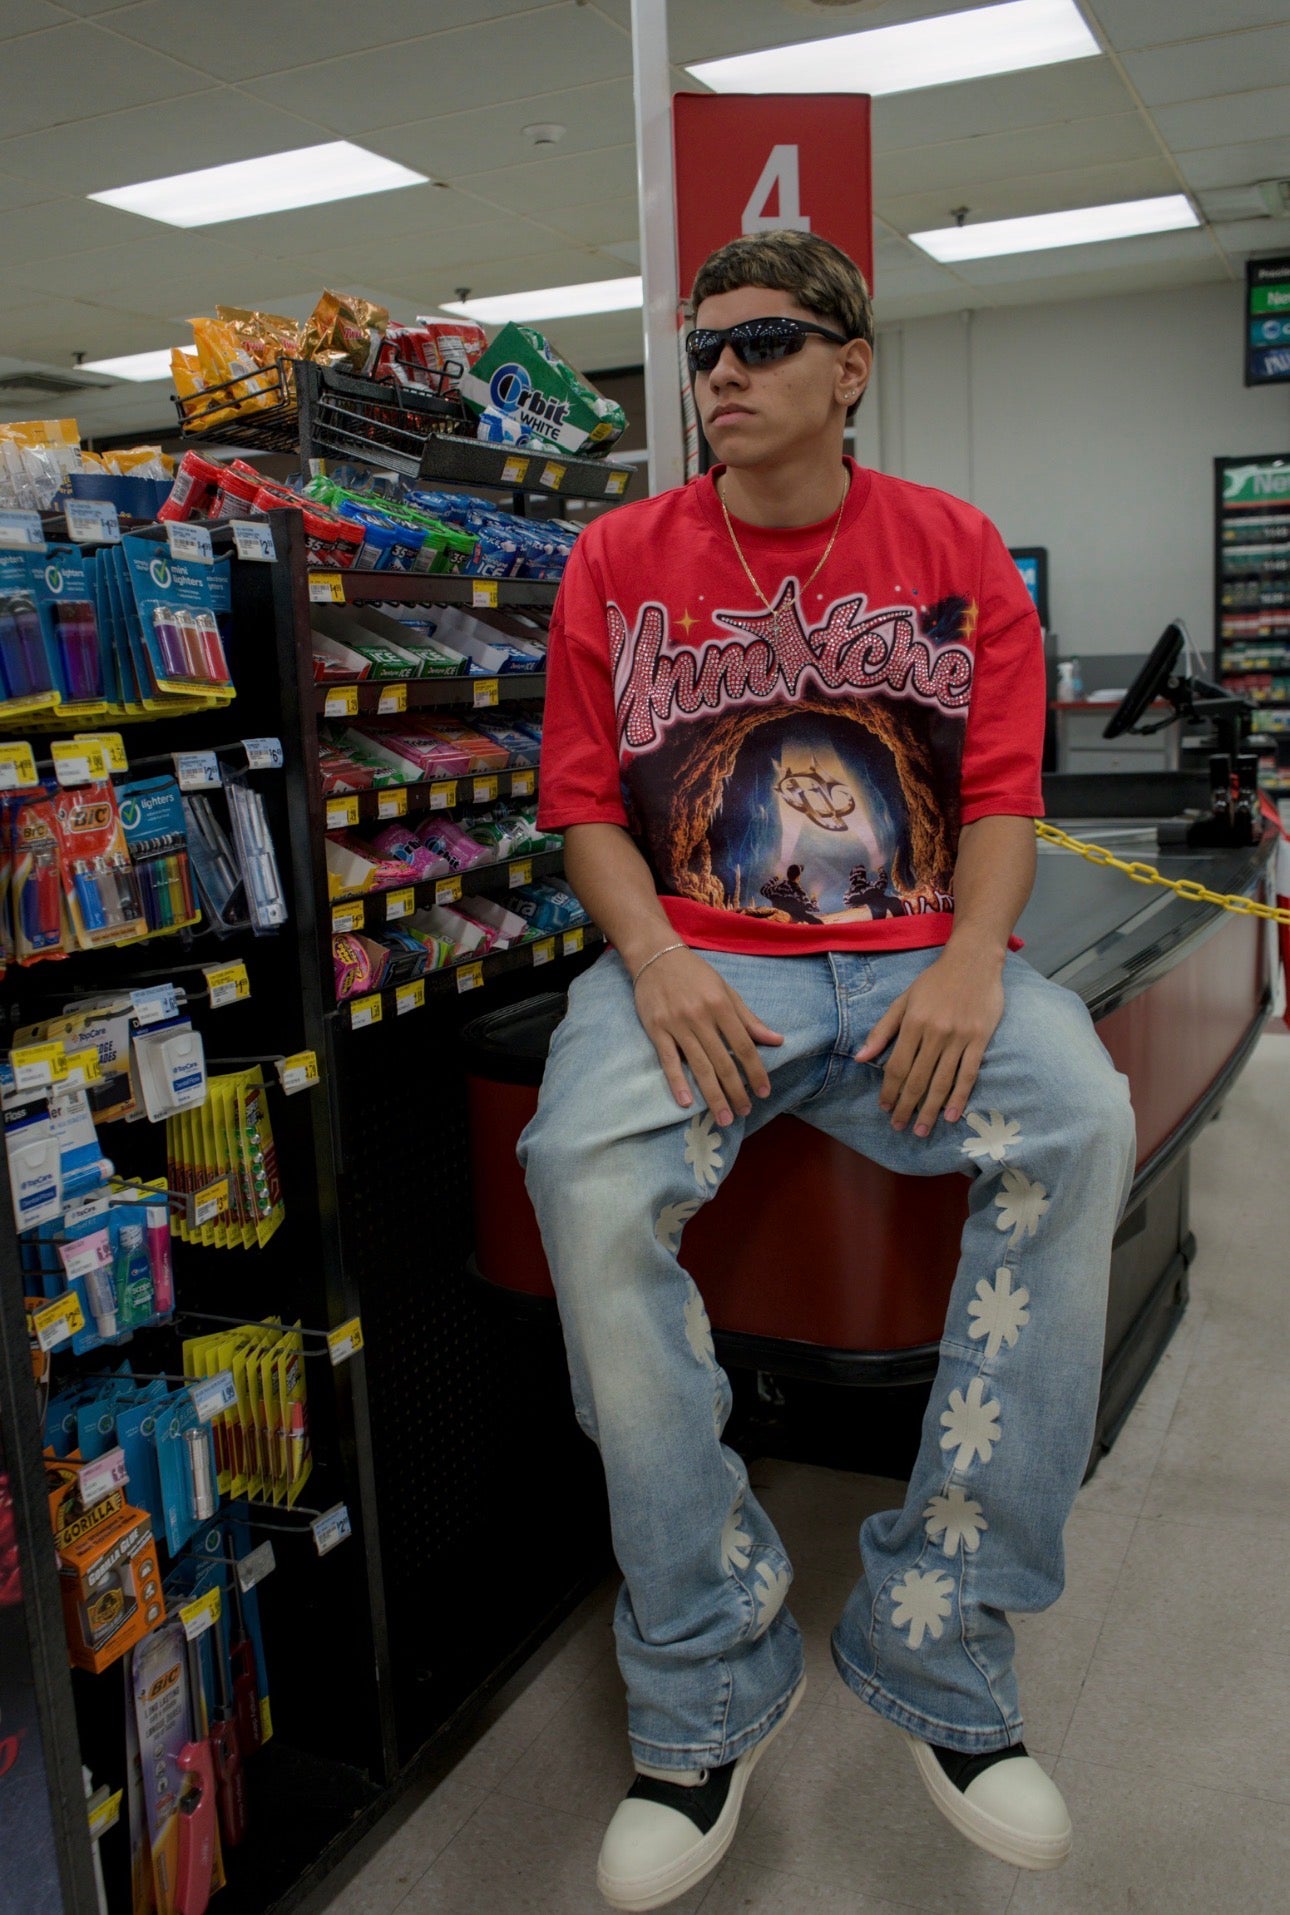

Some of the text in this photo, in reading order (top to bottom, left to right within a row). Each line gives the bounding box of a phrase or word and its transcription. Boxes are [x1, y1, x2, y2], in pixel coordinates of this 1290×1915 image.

[741, 144, 811, 236] 4
[489, 363, 570, 427] Orbit
[519, 411, 561, 442] WHITE
[305, 537, 323, 551] 35
[391, 544, 407, 558] 35
[450, 552, 465, 563] 35
[477, 561, 506, 576] ICE
[173, 576, 203, 587] lighters
[370, 651, 401, 663] ICE
[398, 668, 412, 678] ICE
[444, 666, 456, 676] ICE
[141, 793, 175, 810] lighters
[97, 1041, 113, 1054] DGE
[99, 1051, 117, 1064] ADES
[4, 1108, 27, 1123] Floss
[63, 1500, 115, 1543] GORILLA
[151, 1667, 178, 1697] BIC
